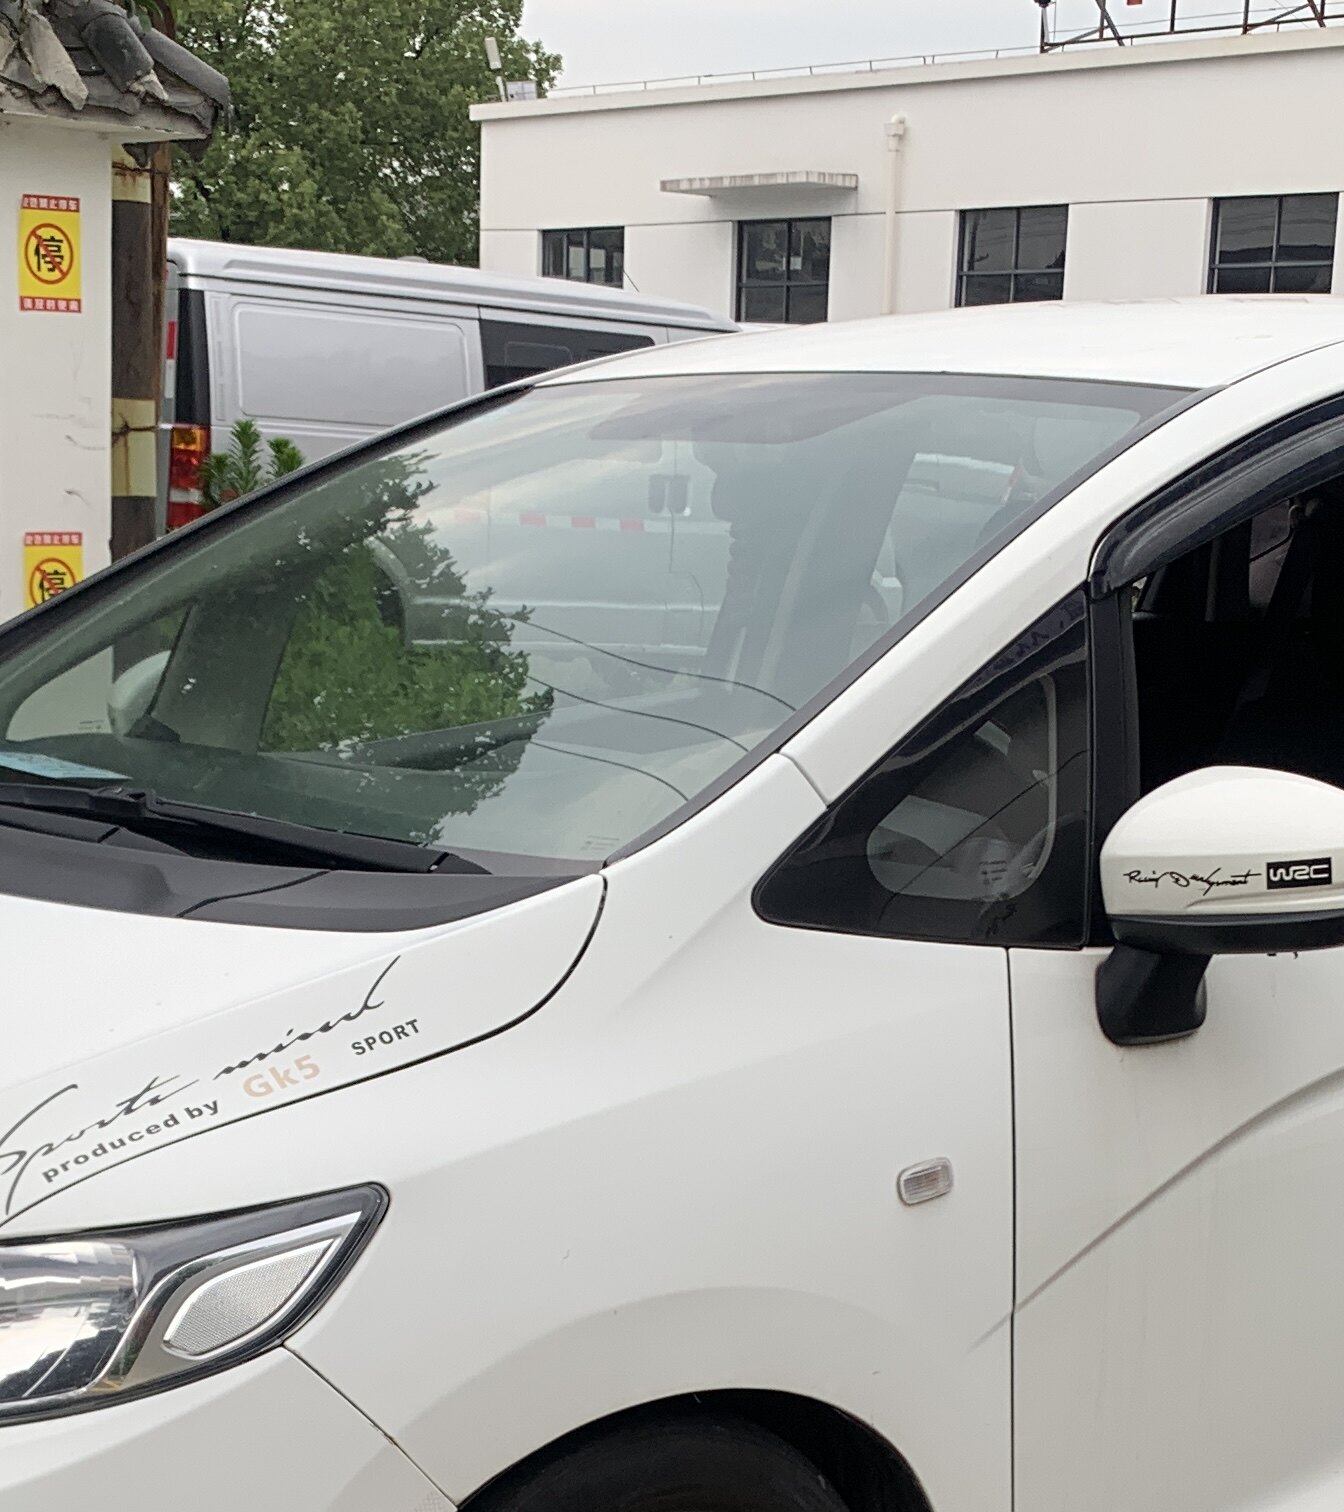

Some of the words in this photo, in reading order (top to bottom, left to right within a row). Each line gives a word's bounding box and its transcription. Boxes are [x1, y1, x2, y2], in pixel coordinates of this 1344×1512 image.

[1269, 863, 1330, 882] WRC
[42, 1113, 180, 1183] produced
[184, 1099, 220, 1121] by
[351, 1018, 420, 1056] SPORT
